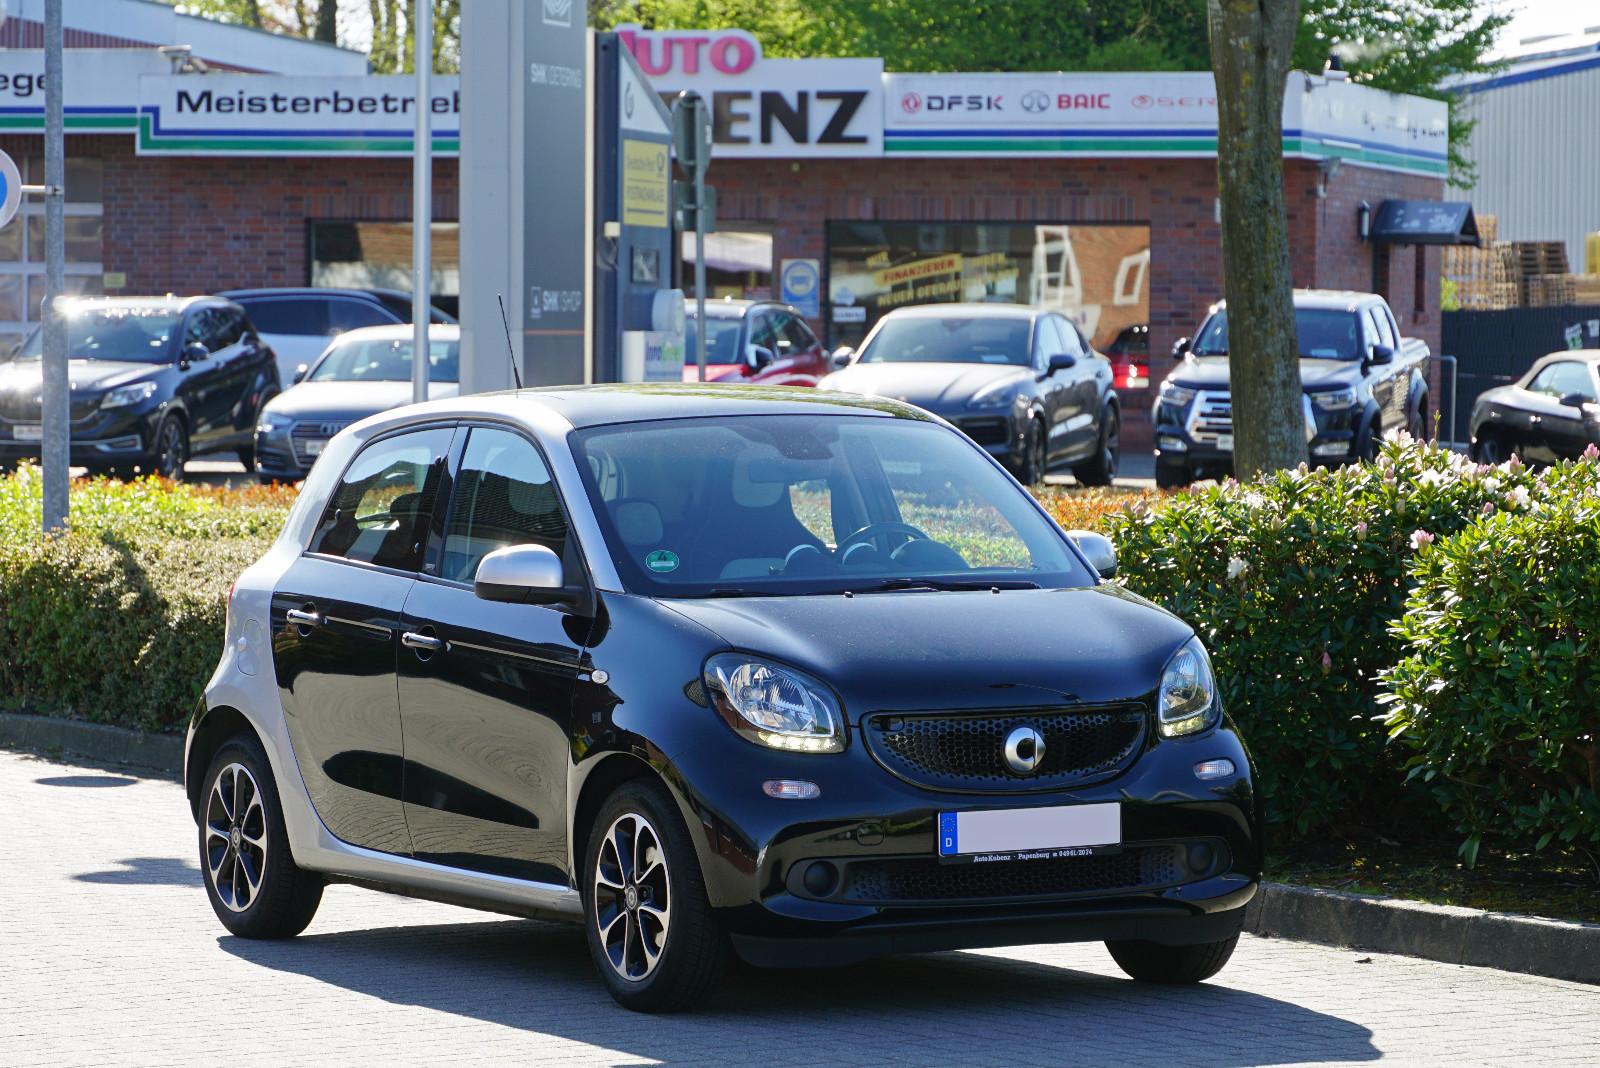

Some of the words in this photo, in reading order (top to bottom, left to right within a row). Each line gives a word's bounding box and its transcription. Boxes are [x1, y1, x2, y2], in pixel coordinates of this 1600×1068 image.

[926, 95, 1003, 110] DFSK
[1057, 94, 1111, 109] BAIC
[945, 837, 953, 848] D
